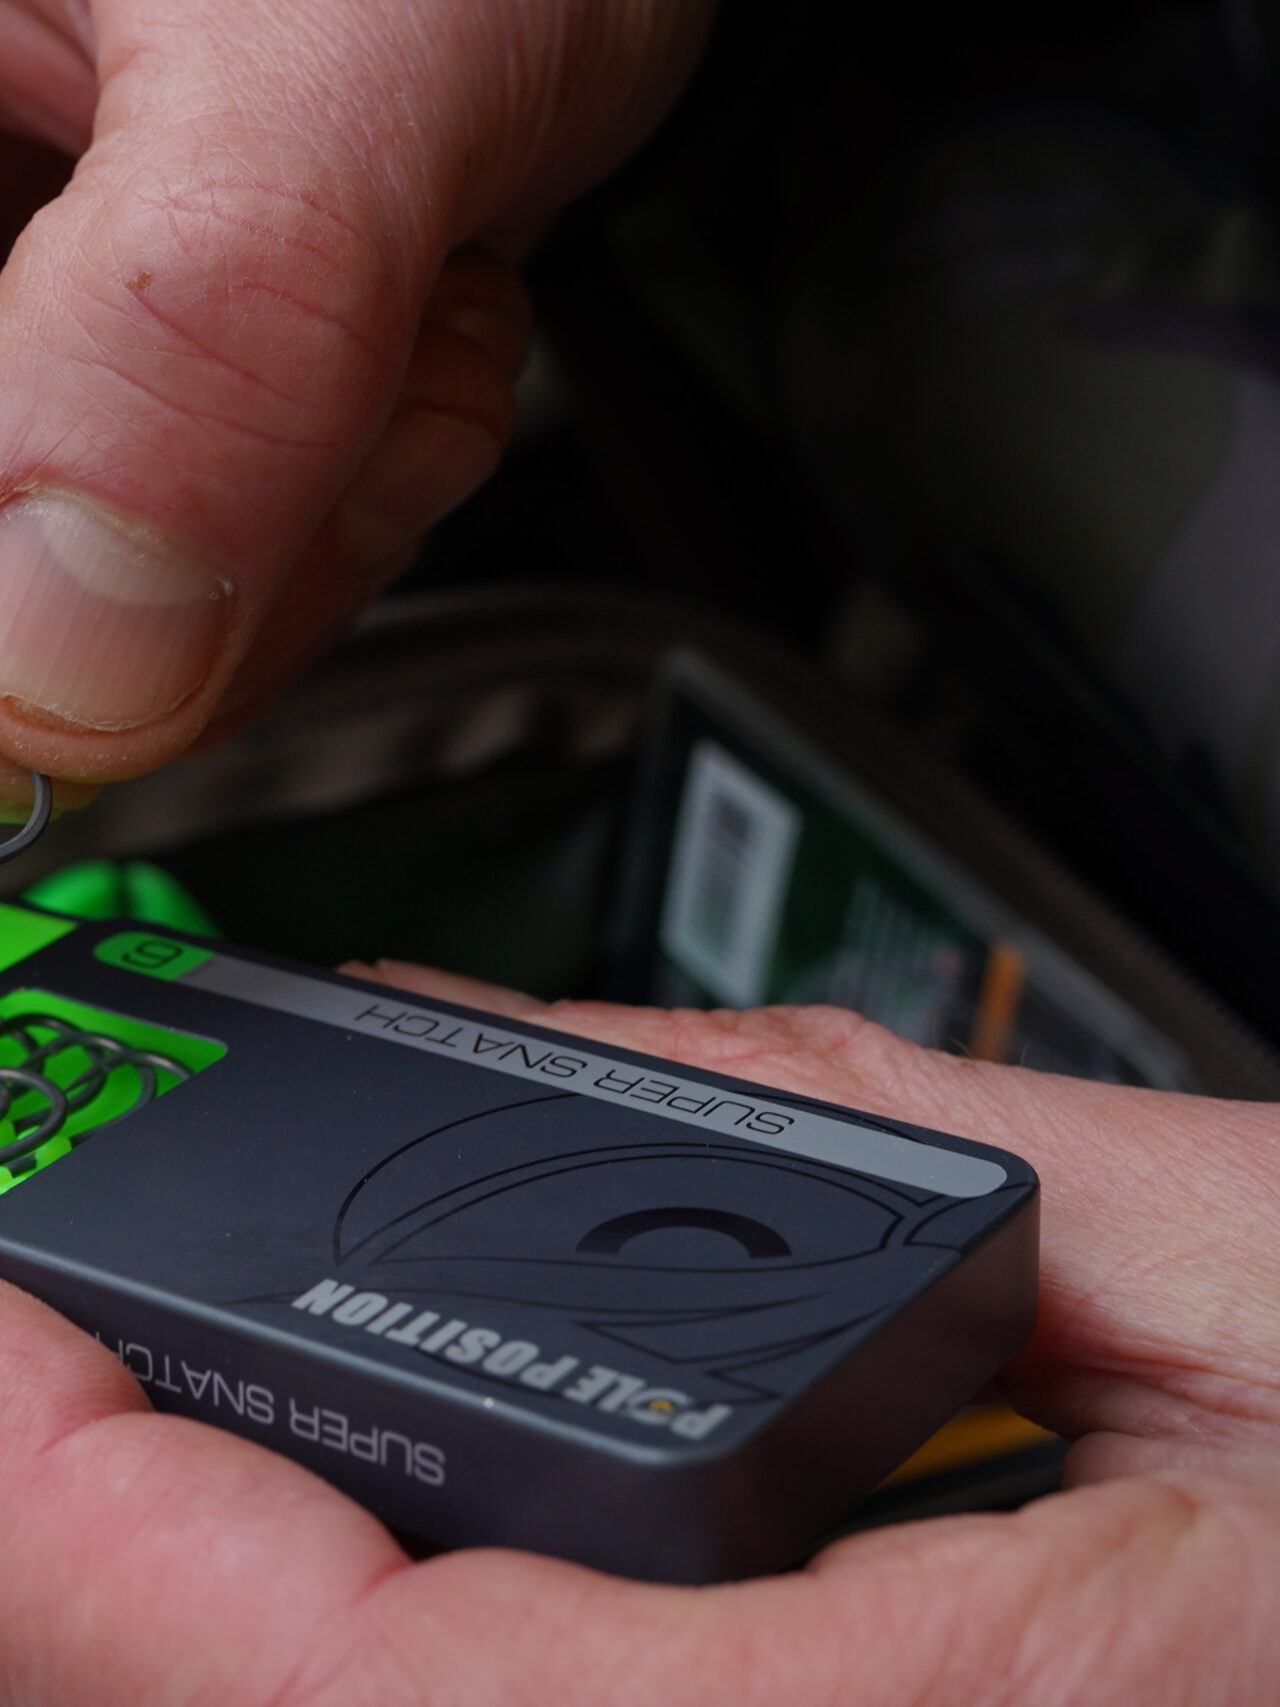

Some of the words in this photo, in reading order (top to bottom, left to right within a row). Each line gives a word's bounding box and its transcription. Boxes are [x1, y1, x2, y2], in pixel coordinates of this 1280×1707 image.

[354, 1003, 589, 1079] SNATCH
[593, 1068, 796, 1136] SUPER
[291, 1278, 580, 1391] POSITION
[562, 1365, 733, 1440] POLE
[288, 1397, 446, 1487] SUPER
